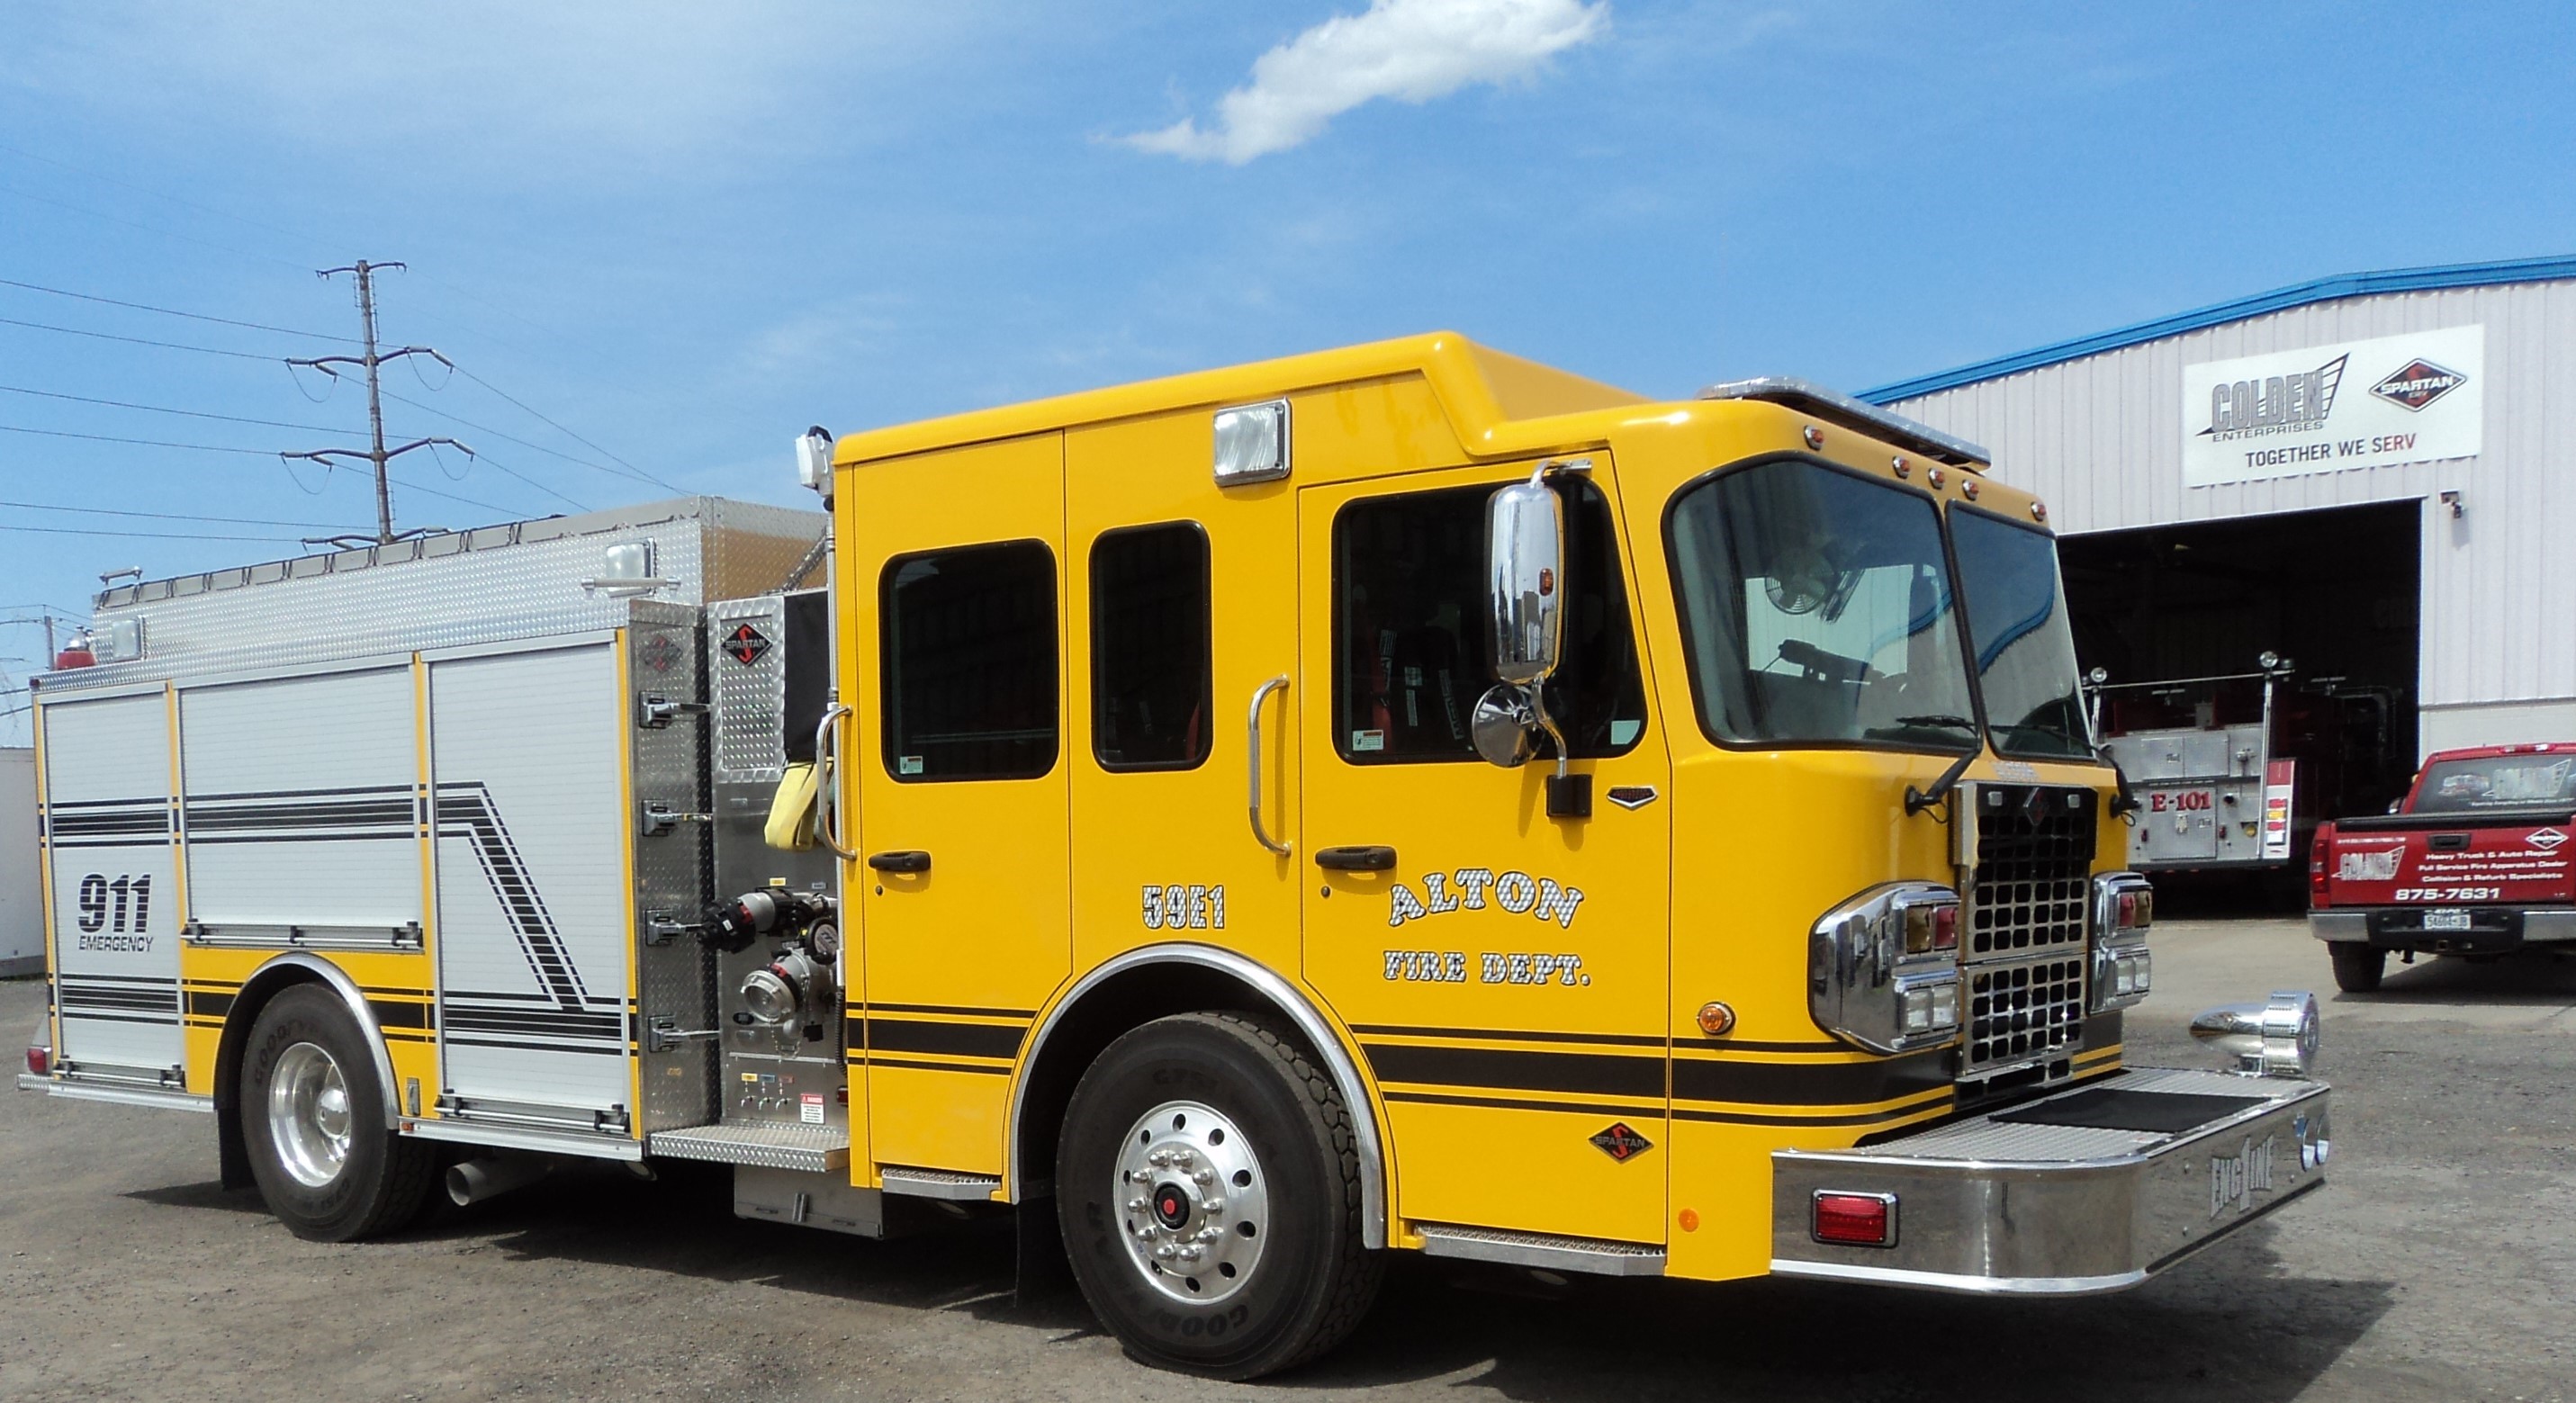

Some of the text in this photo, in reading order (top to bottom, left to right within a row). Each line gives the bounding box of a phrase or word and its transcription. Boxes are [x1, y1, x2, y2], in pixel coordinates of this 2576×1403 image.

[2380, 375, 2454, 395] SPARTAN
[2211, 369, 2324, 433] COLDEN
[2212, 420, 2324, 443] ENTERPRISES
[2246, 433, 2417, 468] TOGETHER WE SERV
[725, 638, 765, 650] SPARTAN
[2151, 790, 2211, 813] E-101
[78, 873, 151, 933] 911
[1389, 868, 1584, 929] ALTON
[2395, 887, 2500, 900] 875-7631
[1141, 885, 1225, 930] 59E1
[78, 935, 154, 952] EMERGENCY
[1383, 950, 1590, 985] FIRE DEPT.
[1595, 1136, 1645, 1147] SPARTAN
